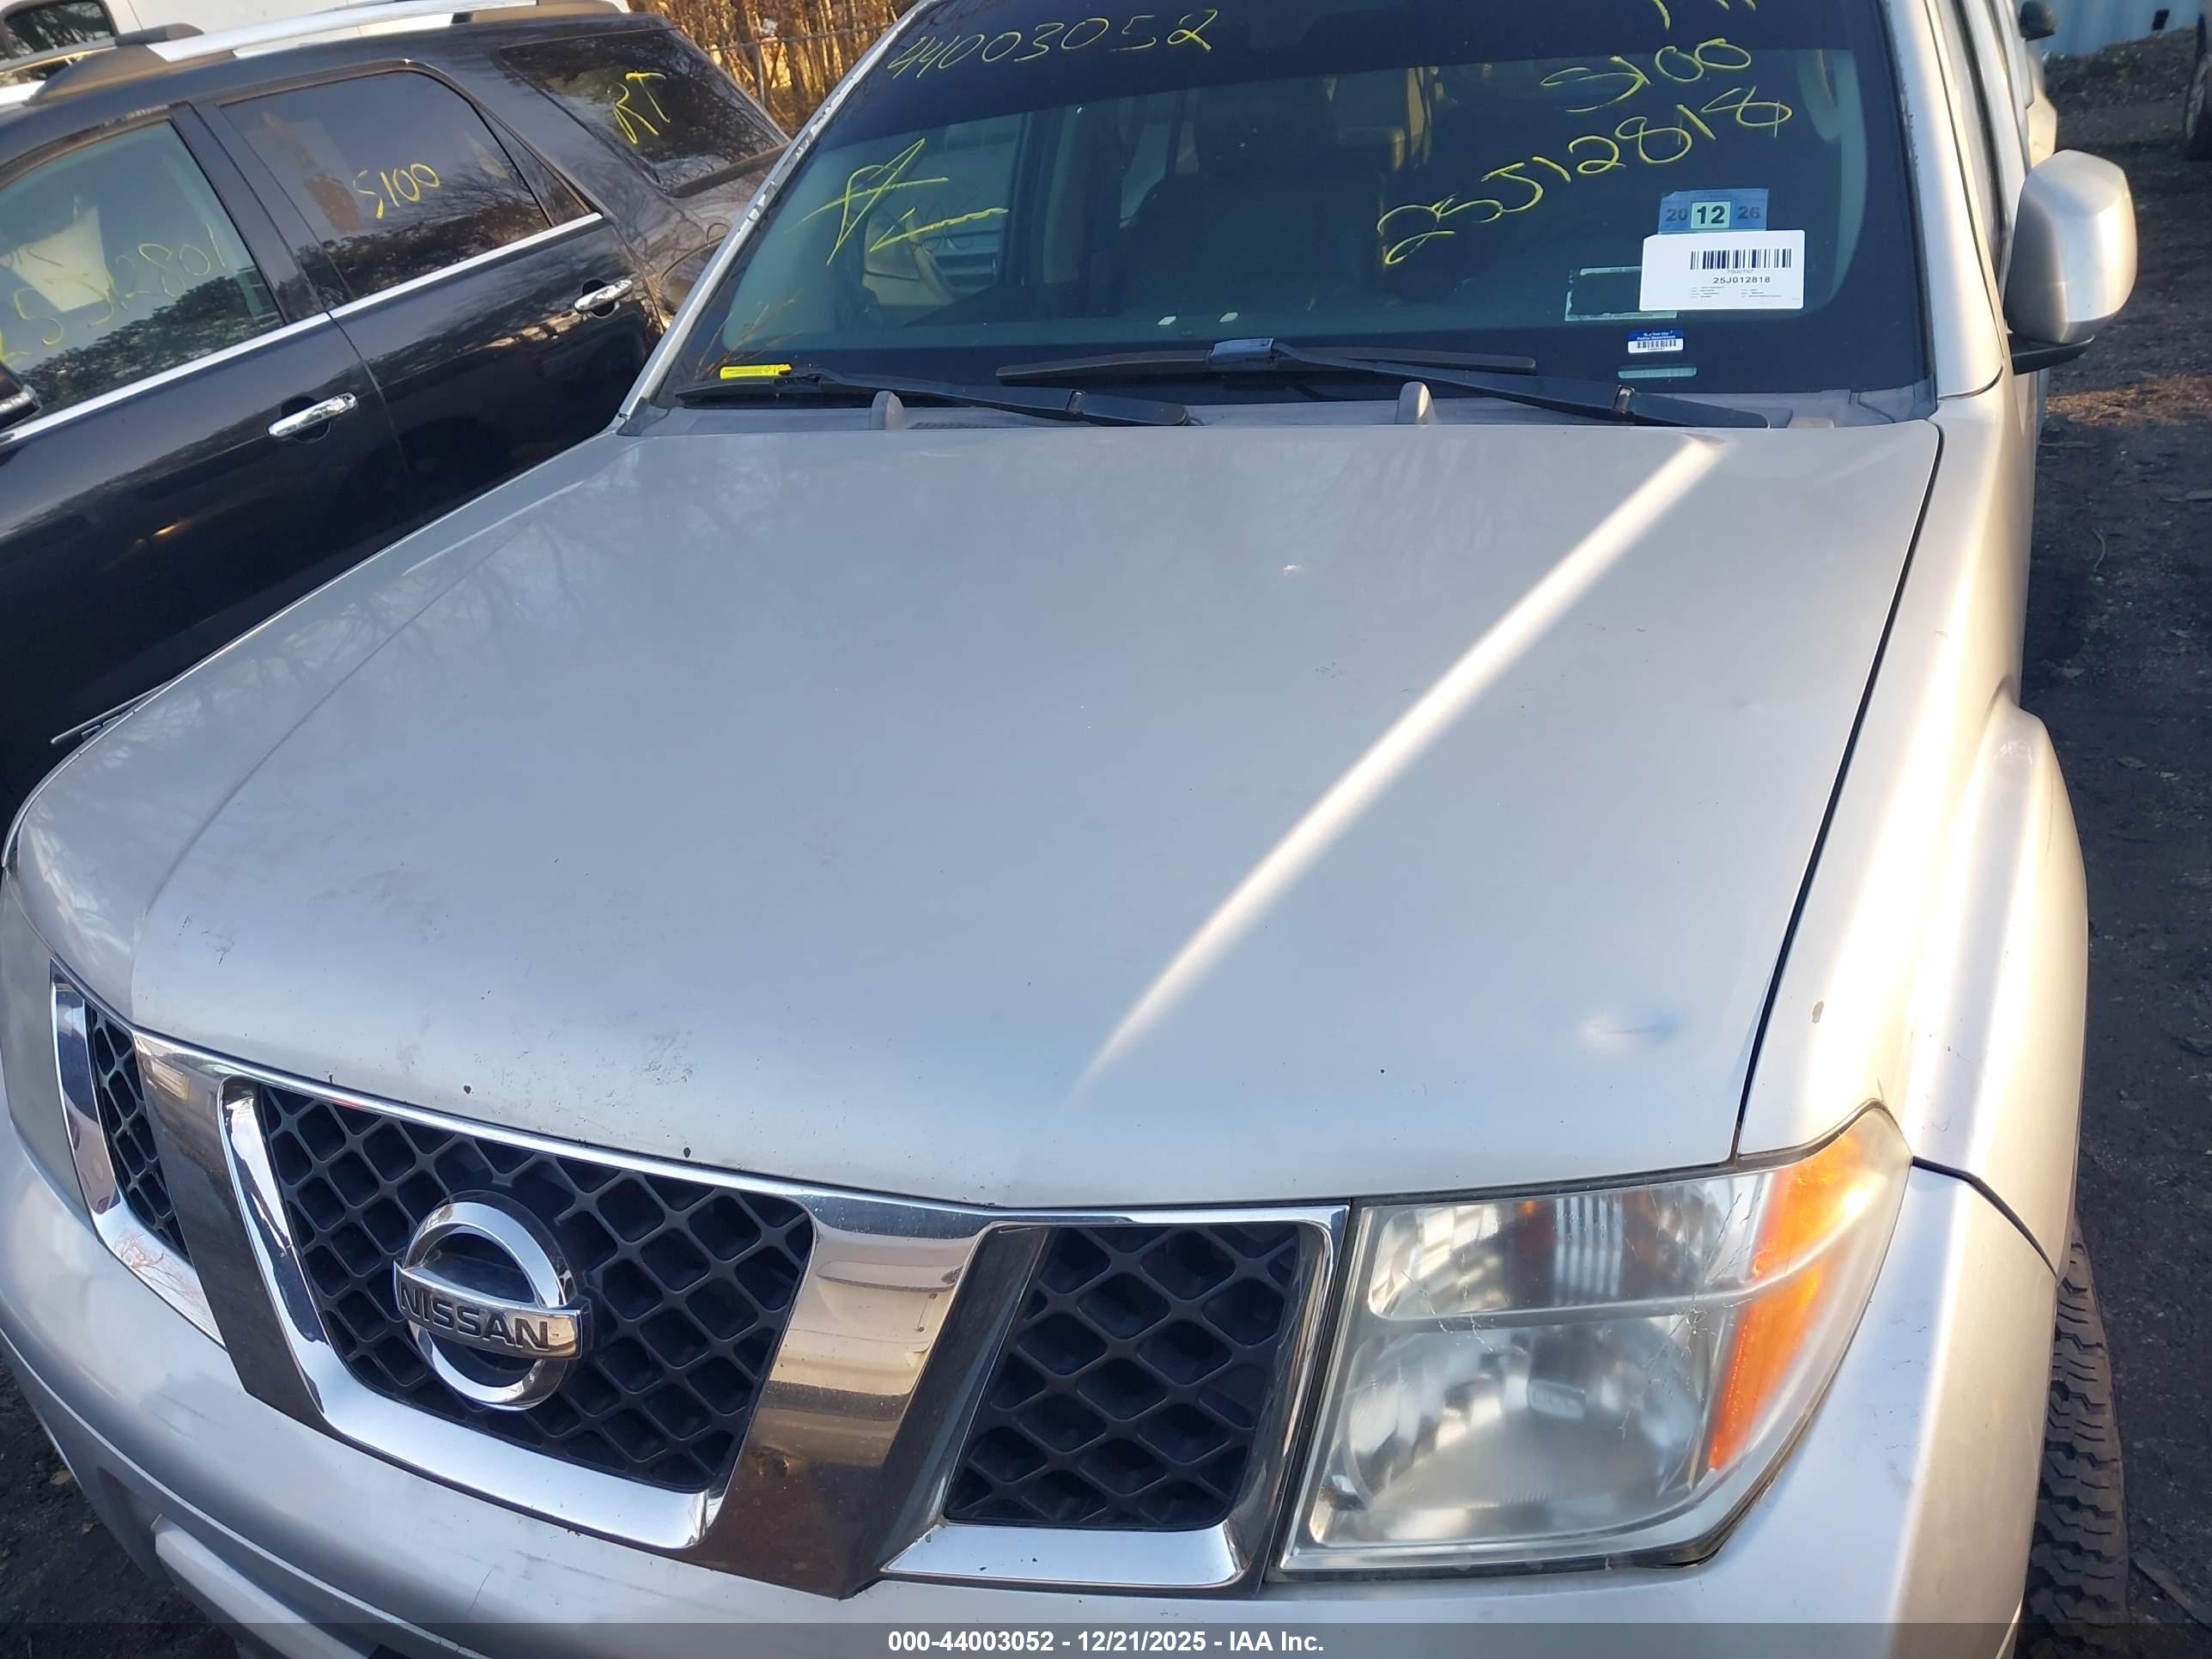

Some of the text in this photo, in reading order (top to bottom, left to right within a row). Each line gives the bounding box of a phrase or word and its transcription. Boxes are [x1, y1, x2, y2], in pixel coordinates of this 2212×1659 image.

[886, 8, 1218, 79] 44003052
[1666, 205, 1761, 224] 20 12 26
[1712, 276, 1771, 284] 25J012818
[399, 1279, 551, 1352] NISSAN
